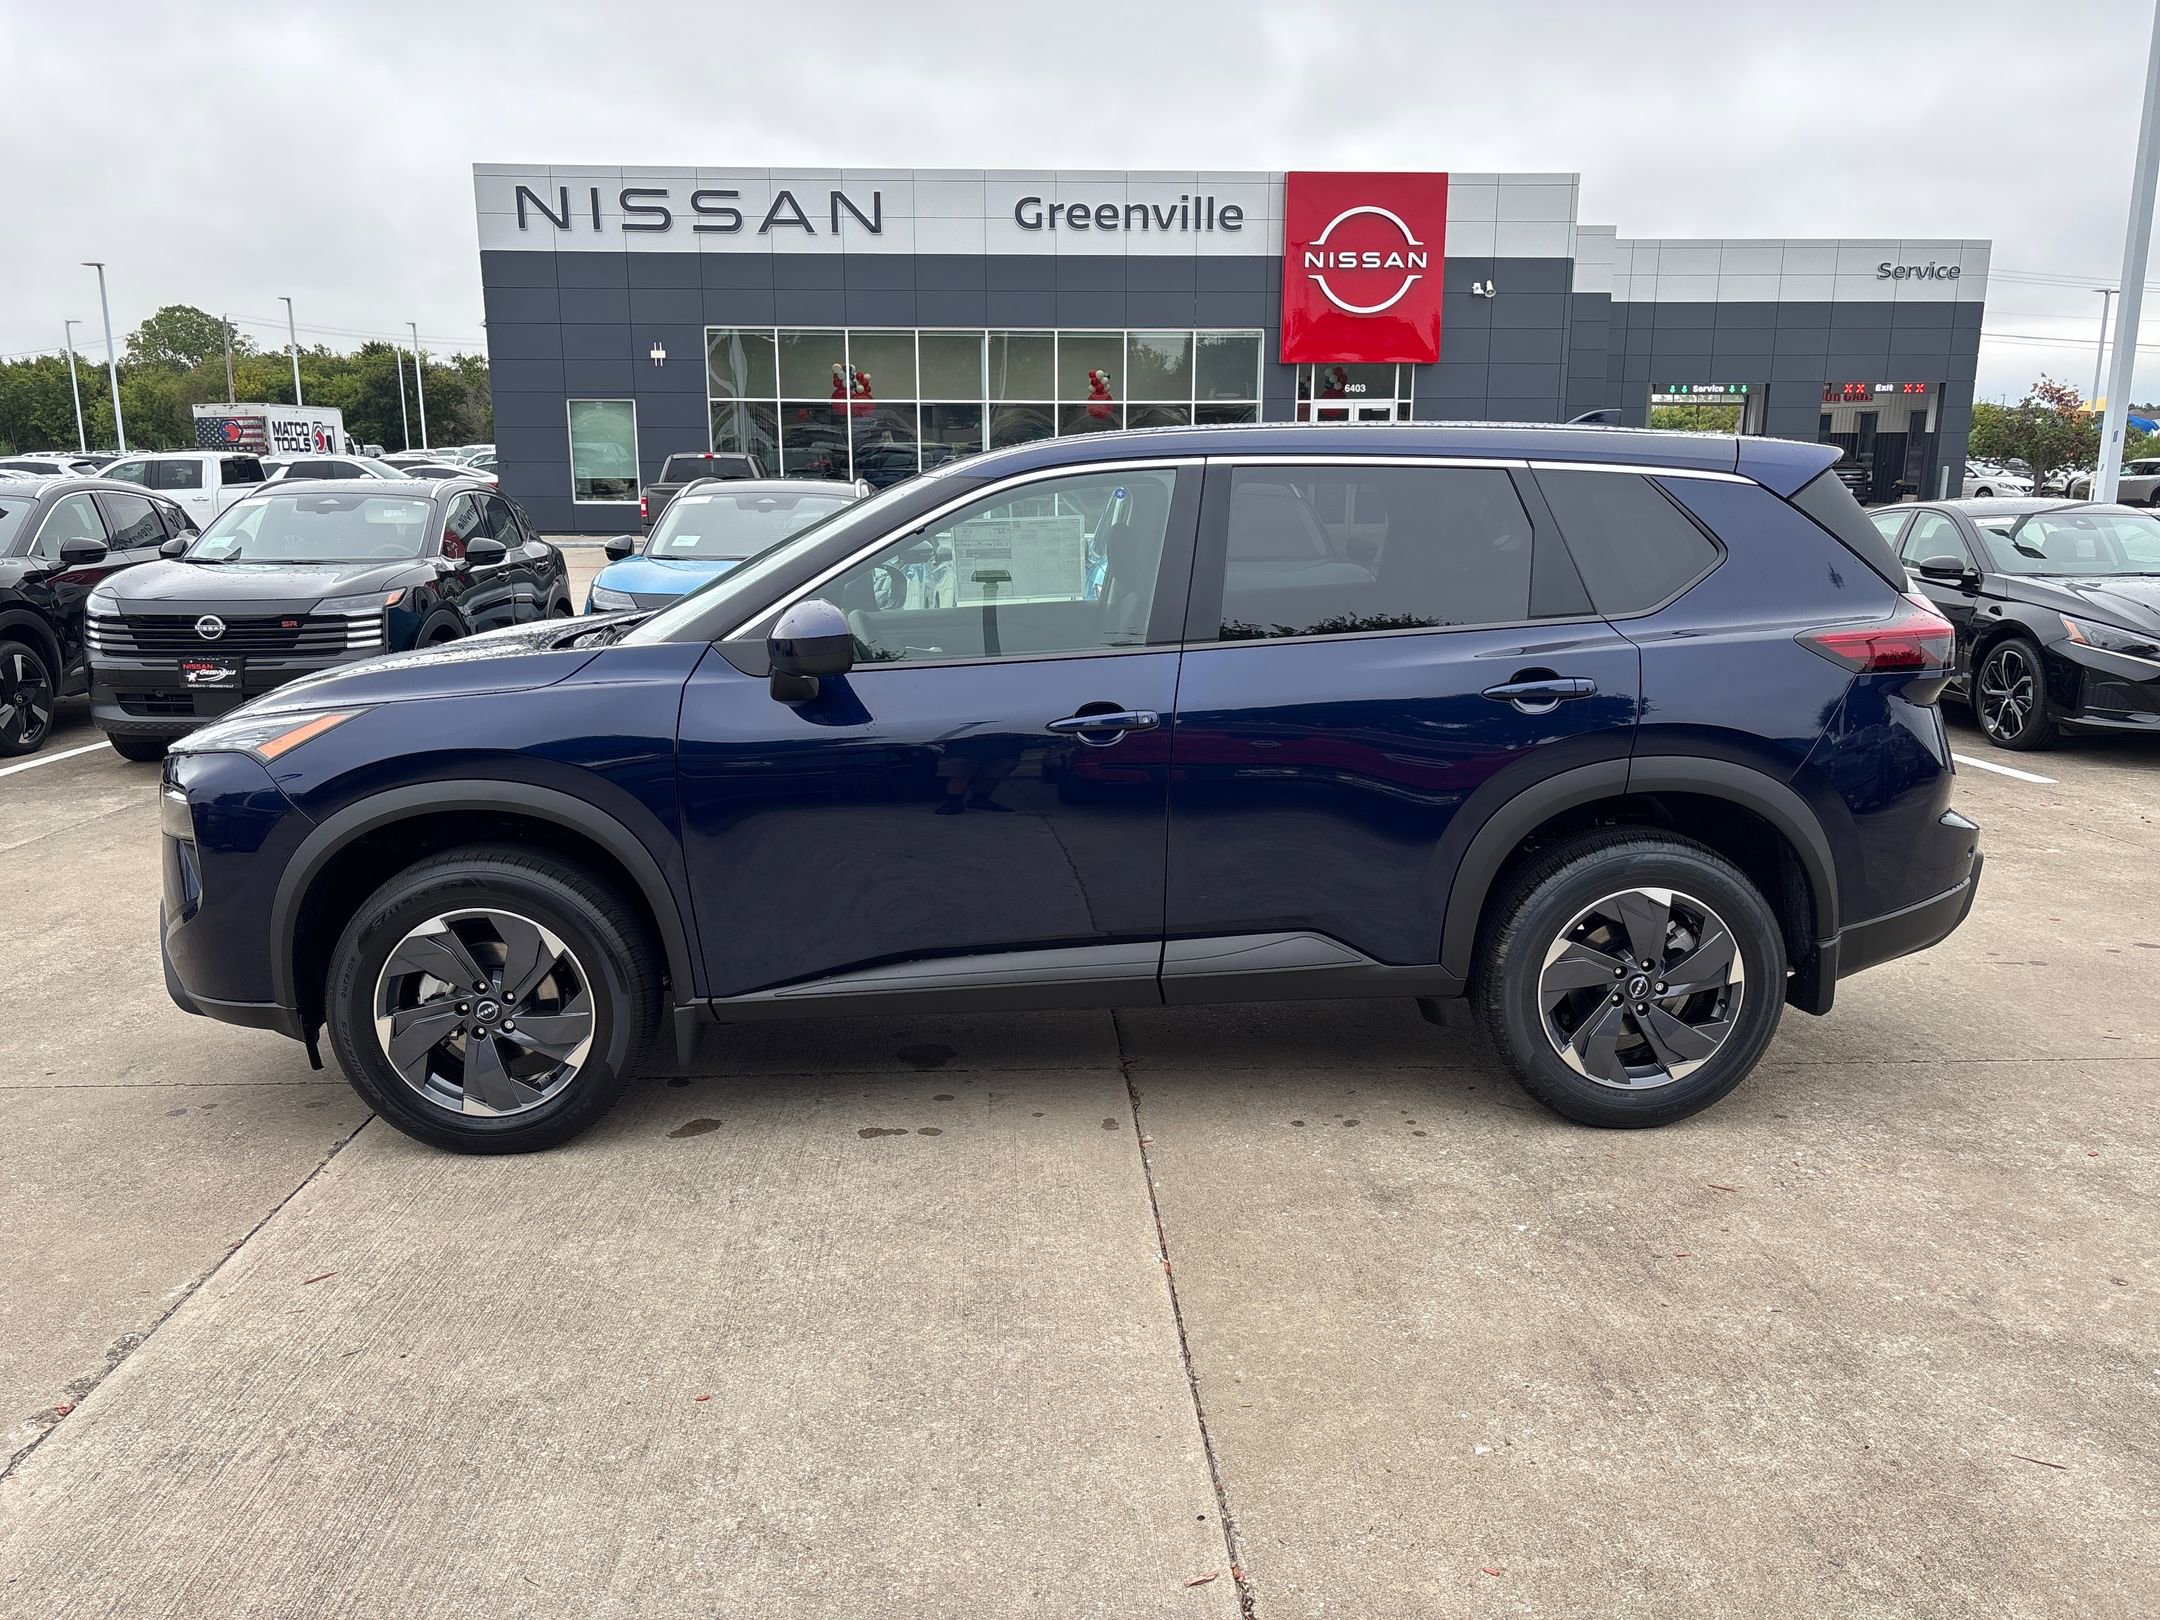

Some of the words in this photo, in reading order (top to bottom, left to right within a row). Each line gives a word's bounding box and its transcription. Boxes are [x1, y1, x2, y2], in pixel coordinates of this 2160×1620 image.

[514, 185, 883, 235] NISSAN
[1013, 194, 1245, 232] Greenville
[1304, 251, 1428, 269] NISSAN
[1877, 261, 1961, 280] Service
[1344, 383, 1366, 392] 6403
[1692, 384, 1725, 393] Service
[1874, 383, 1894, 392] Exit
[272, 421, 309, 437] MATCO
[274, 437, 312, 452] TOOLS
